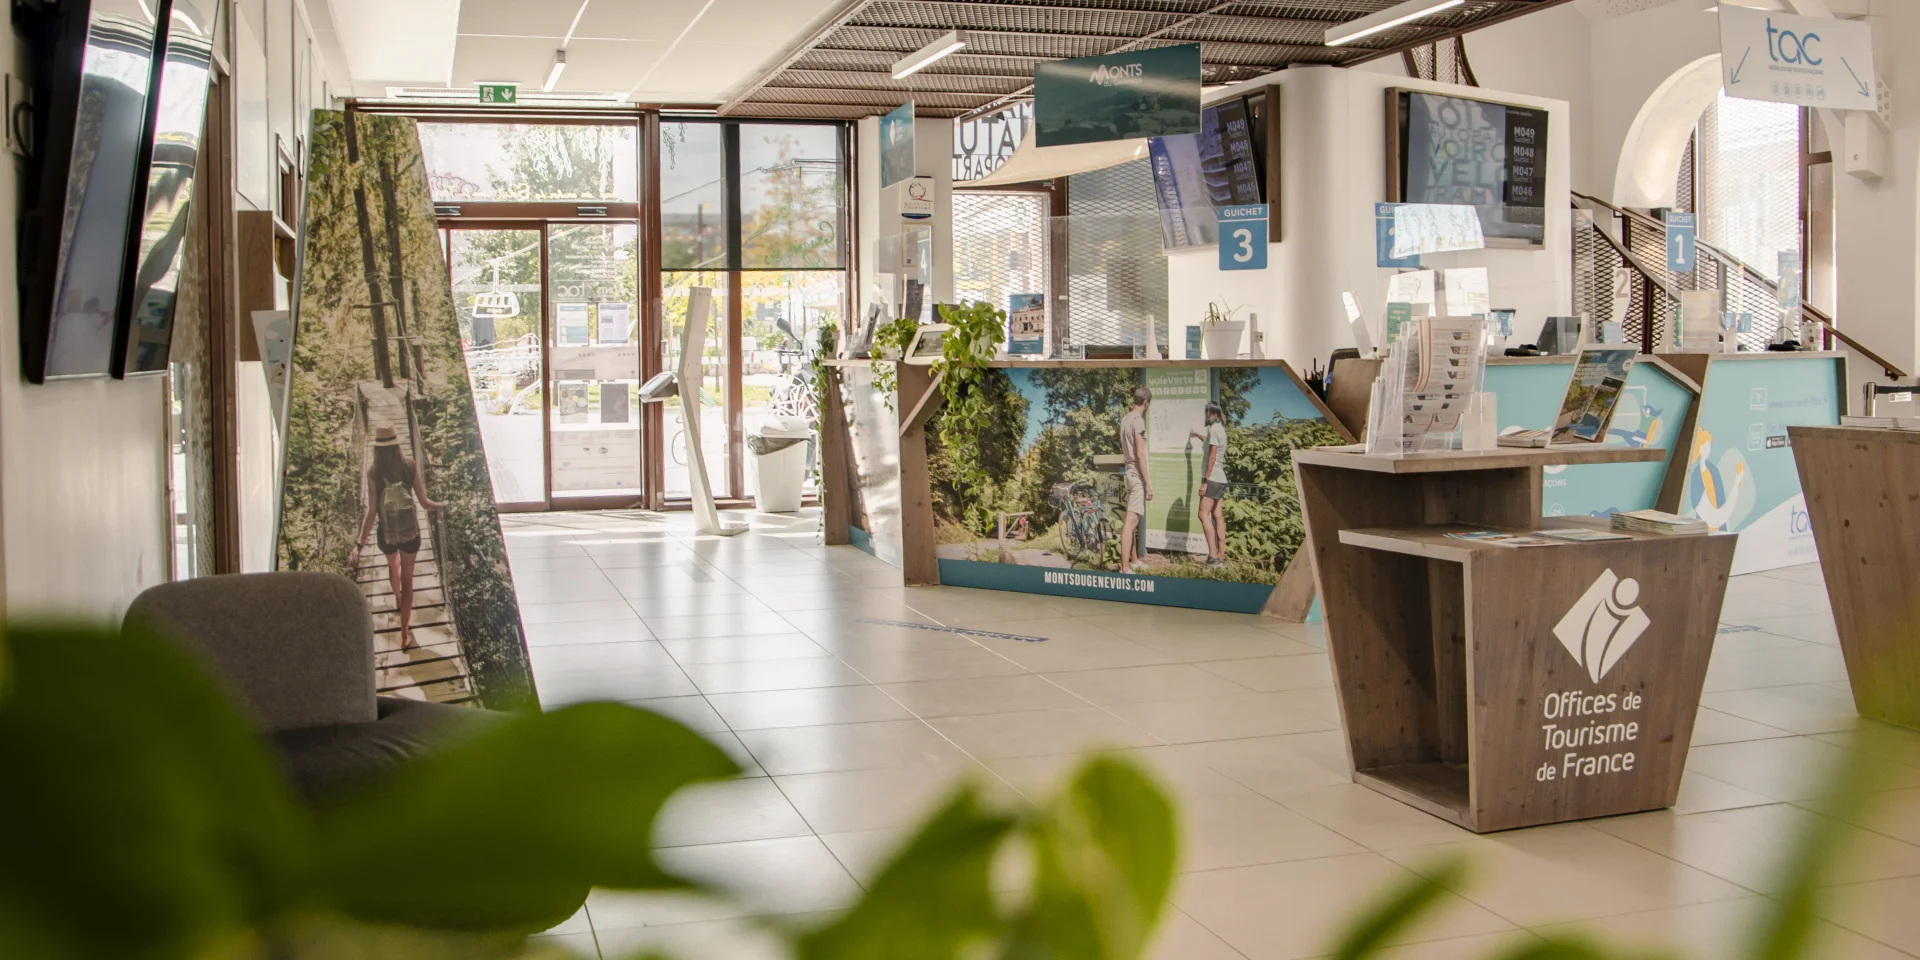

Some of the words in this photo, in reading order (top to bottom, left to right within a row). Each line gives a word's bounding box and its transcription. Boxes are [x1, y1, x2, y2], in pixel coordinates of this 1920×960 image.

[1766, 17, 1823, 66] tac
[1089, 63, 1143, 86] MONTS
[1226, 118, 1245, 133] M049
[1514, 126, 1535, 138] M049
[1230, 140, 1248, 153] M048
[1513, 145, 1535, 158] M048
[1513, 165, 1533, 177] M047
[1512, 185, 1533, 197] M046
[1224, 207, 1263, 217] GUICHET
[1669, 215, 1692, 223] GUICHET
[1233, 228, 1254, 263] 3
[1675, 233, 1686, 265] 1
[920, 247, 928, 276] 4
[1615, 269, 1629, 298] 2
[1543, 478, 1567, 488] AÇONS
[1044, 571, 1154, 593] MONTSDUGENEVOIS.COM
[1544, 690, 1617, 719] Offices
[1622, 691, 1642, 711] de
[1542, 720, 1639, 750] Tourisme
[1536, 763, 1556, 782] de
[1562, 751, 1635, 778] France
